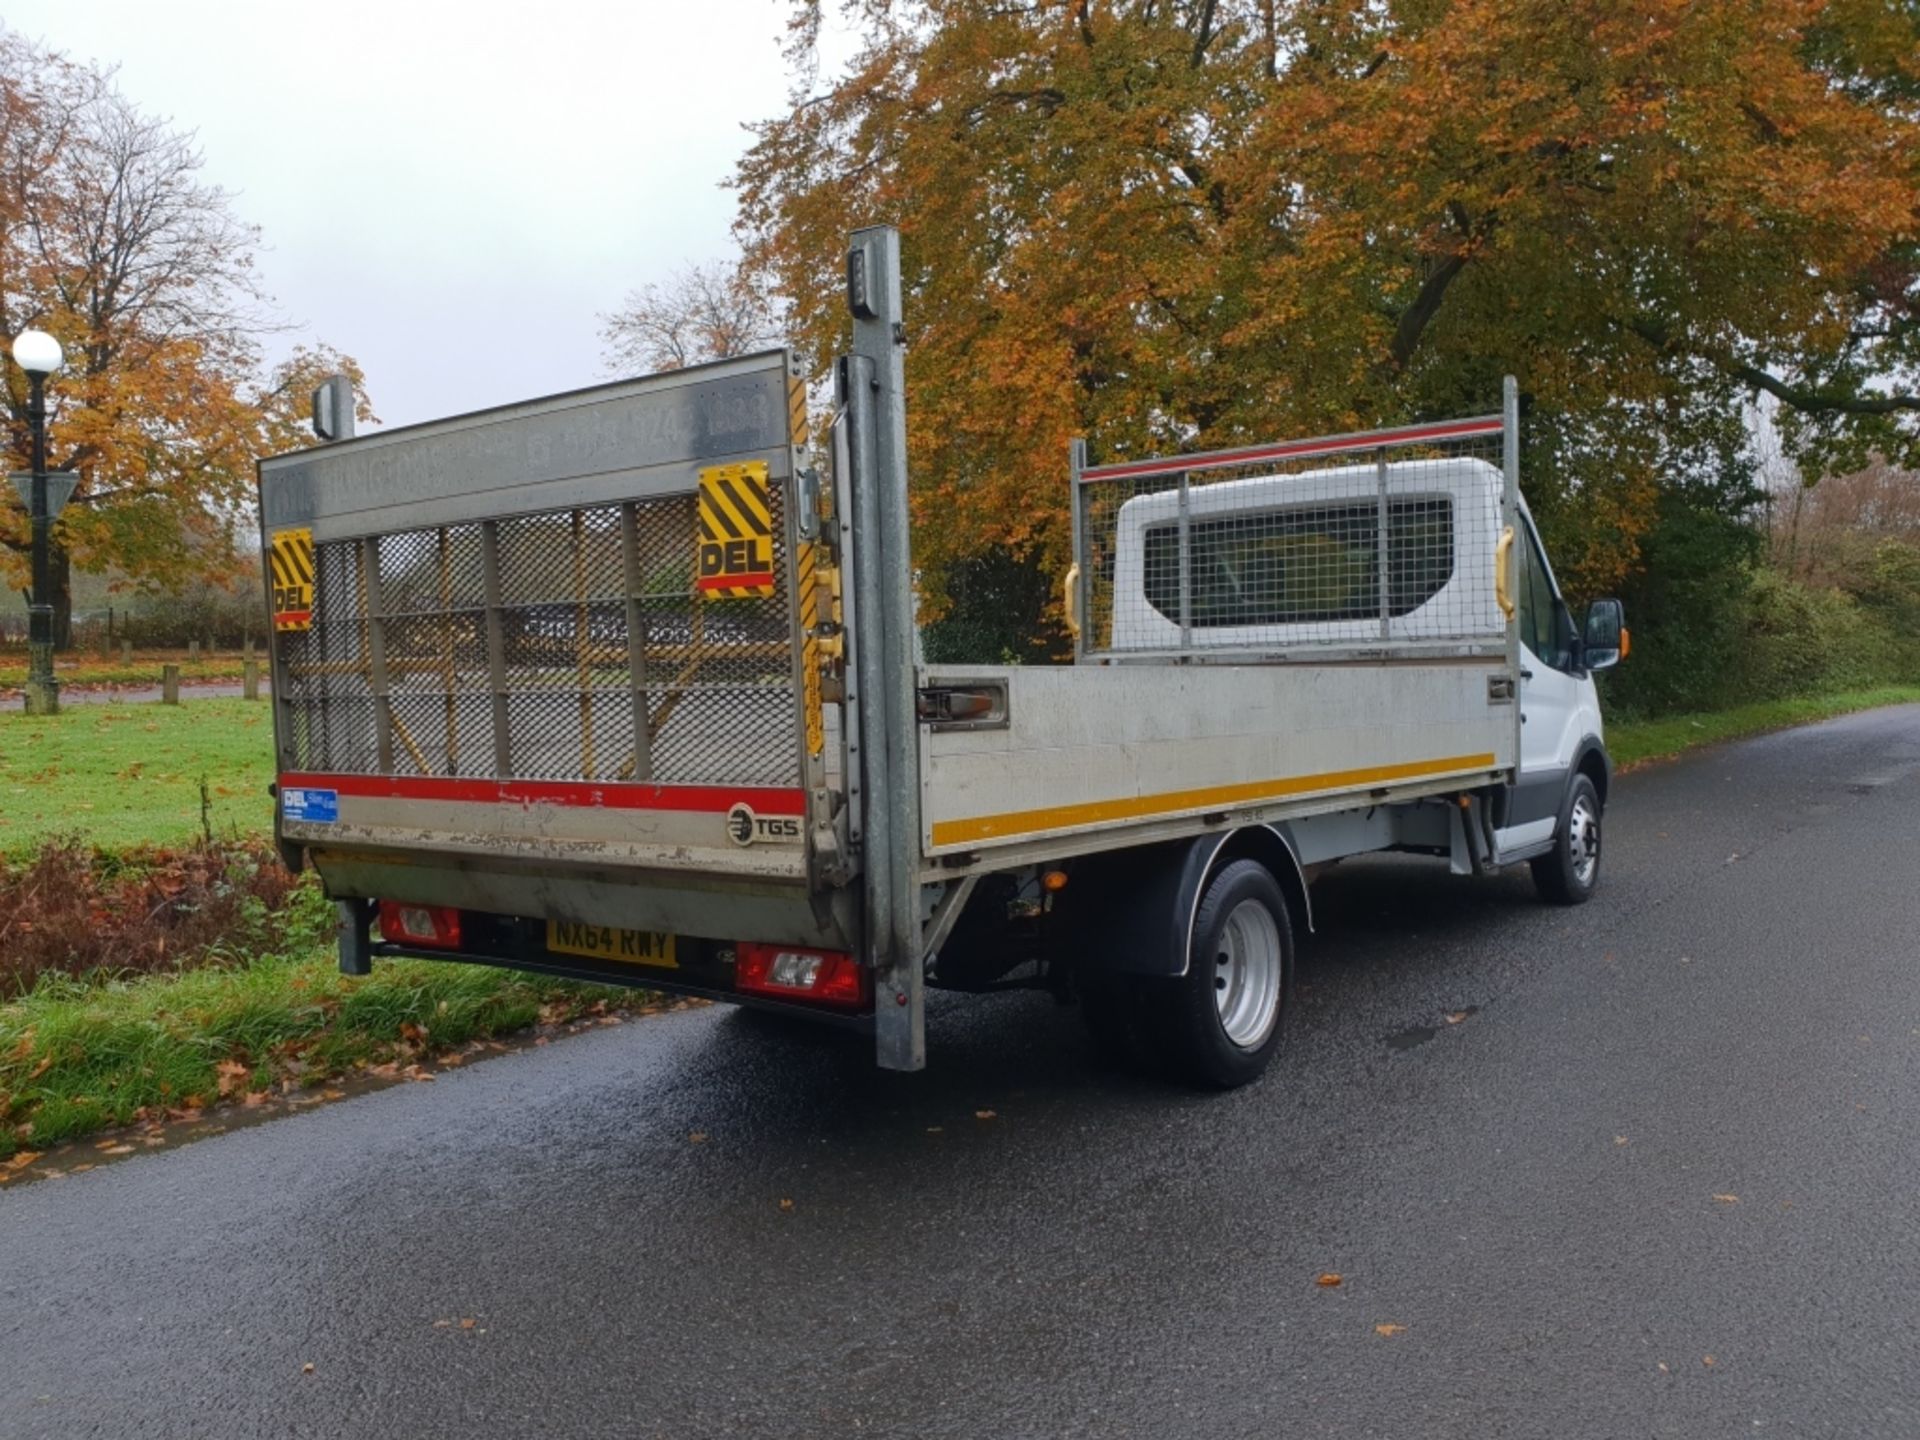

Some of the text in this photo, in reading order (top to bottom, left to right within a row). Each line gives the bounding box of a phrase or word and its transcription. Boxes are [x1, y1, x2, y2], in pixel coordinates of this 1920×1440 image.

[701, 540, 770, 576] DEL
[274, 586, 310, 612] DEL
[755, 819, 799, 836] TGS
[555, 921, 614, 952] NX64
